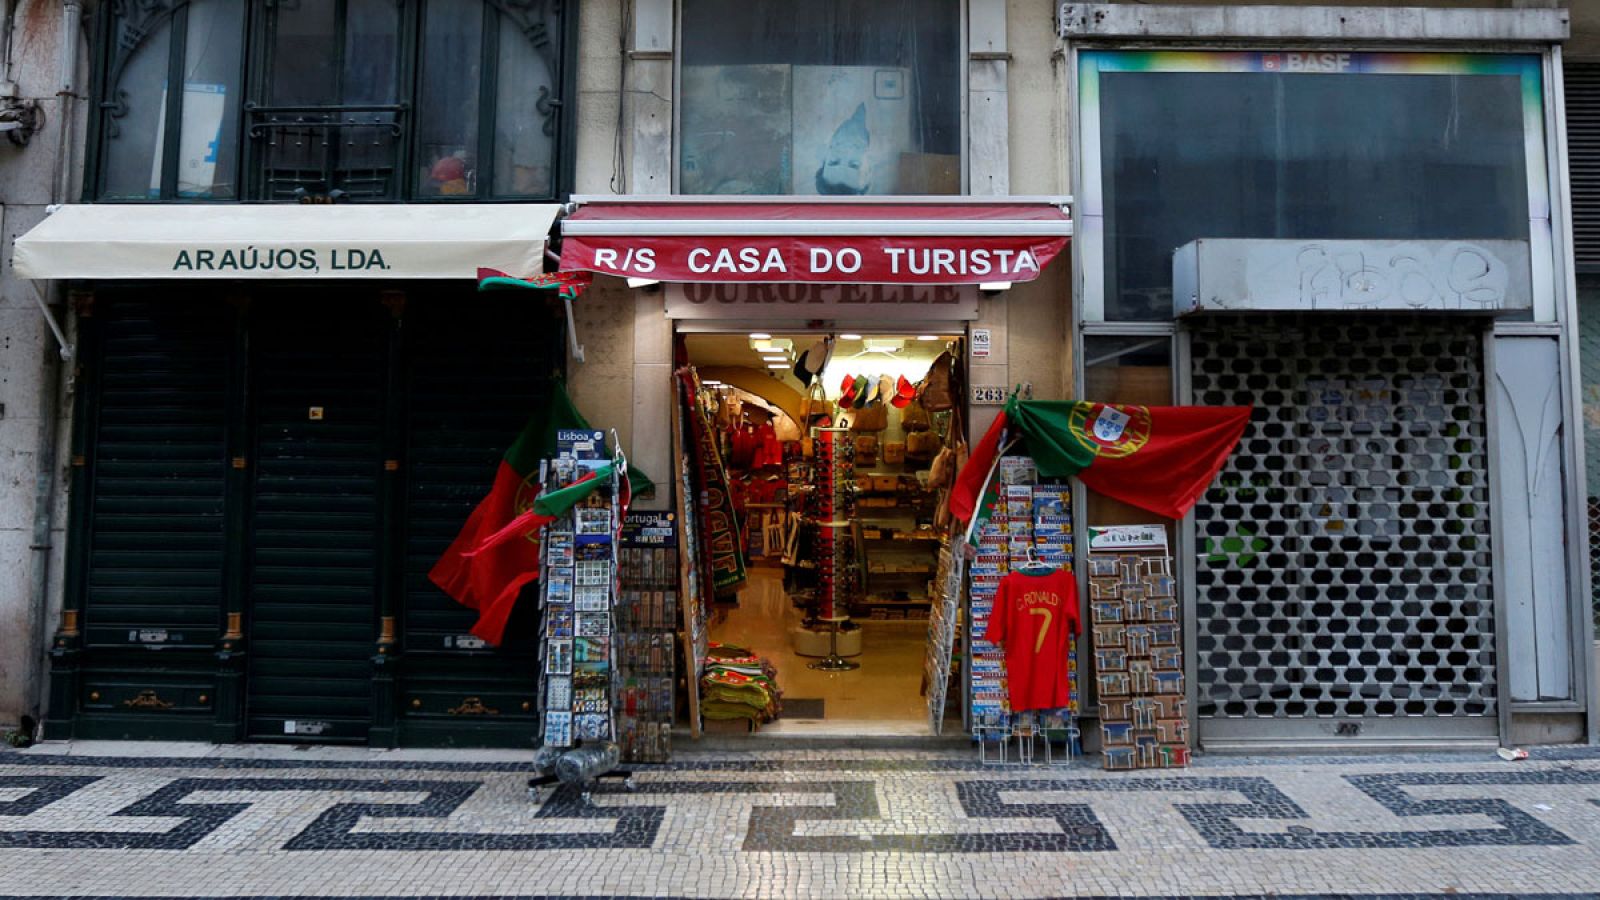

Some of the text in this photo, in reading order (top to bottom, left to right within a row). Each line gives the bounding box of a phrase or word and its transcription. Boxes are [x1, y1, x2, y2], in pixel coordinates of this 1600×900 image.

[1287, 53, 1351, 71] BASF
[172, 245, 391, 273] ARAÚJOS, LDA.
[594, 247, 1039, 275] R/S CASA DO TURISTA
[683, 283, 961, 304] OUROPELLE
[975, 388, 1004, 401] 263
[557, 431, 589, 441] Lisboa
[624, 512, 662, 526] ortugal
[1029, 607, 1053, 654] 7
